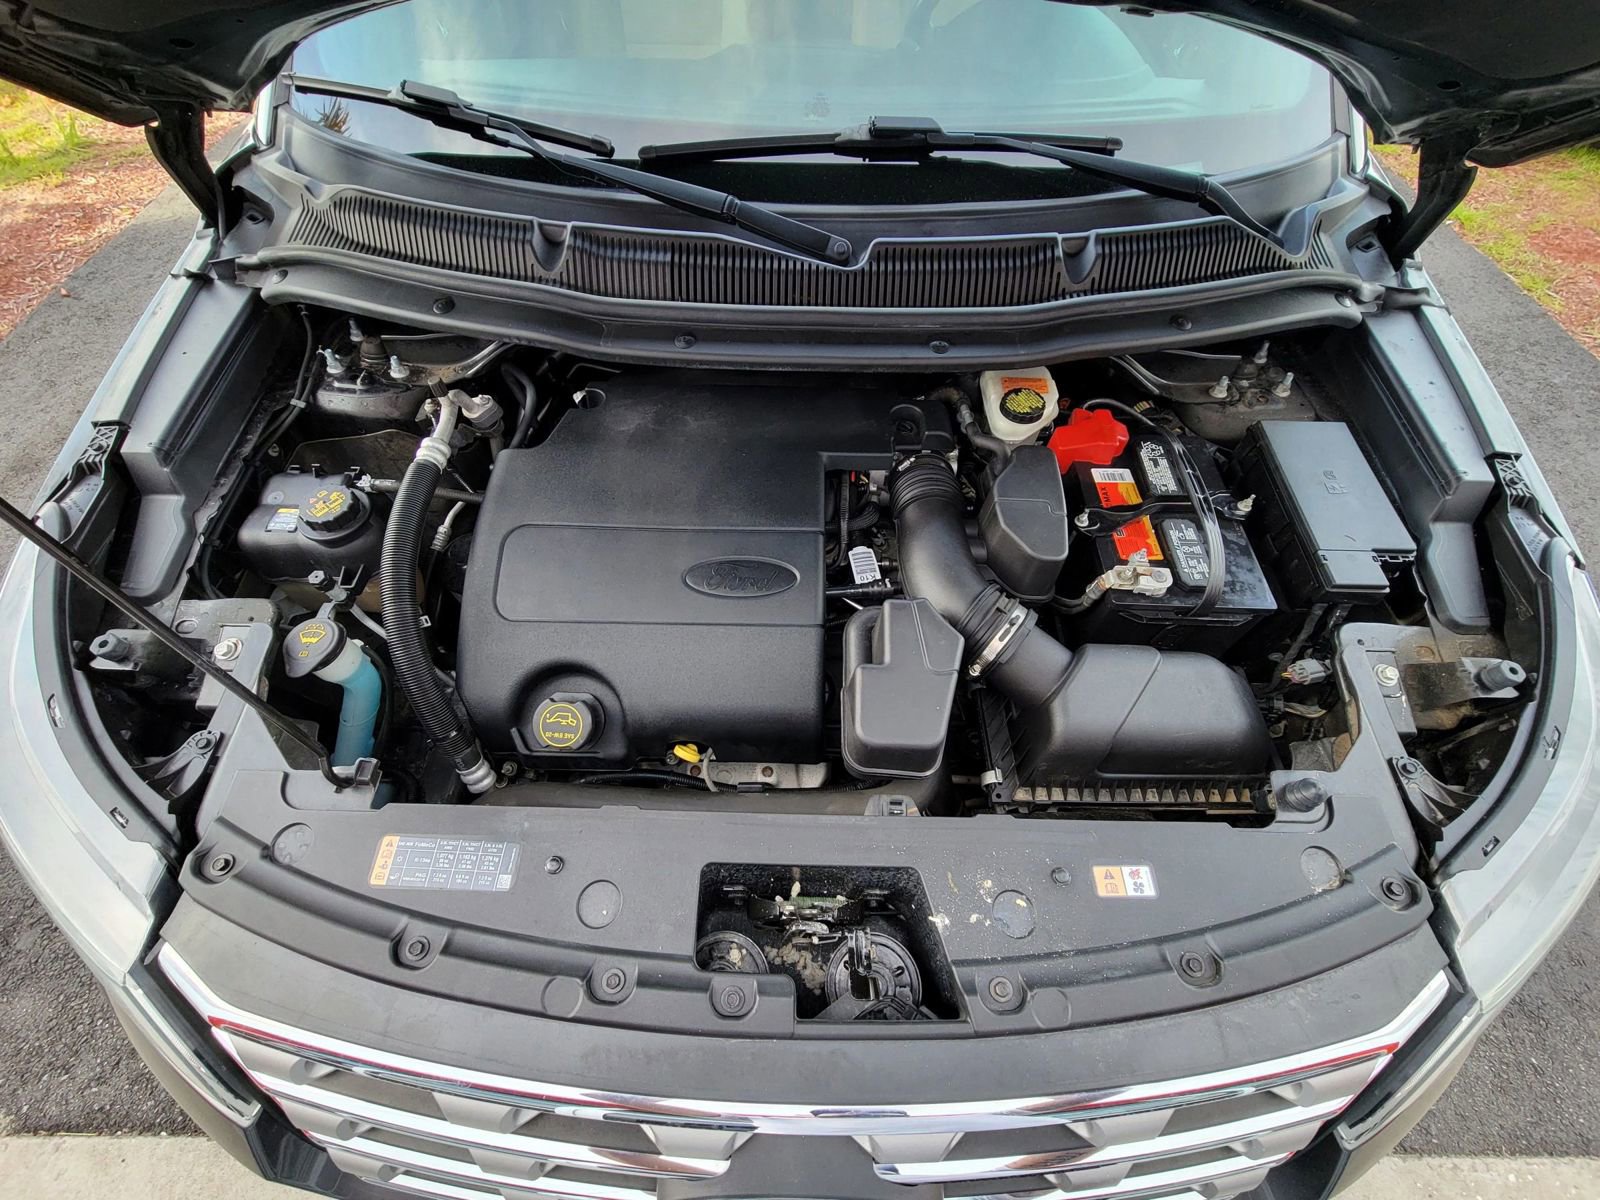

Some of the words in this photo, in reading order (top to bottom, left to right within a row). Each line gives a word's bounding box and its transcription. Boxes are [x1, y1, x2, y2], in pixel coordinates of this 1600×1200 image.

[1101, 486, 1111, 503] MAX
[703, 562, 779, 592] Ford
[860, 574, 876, 582] K10
